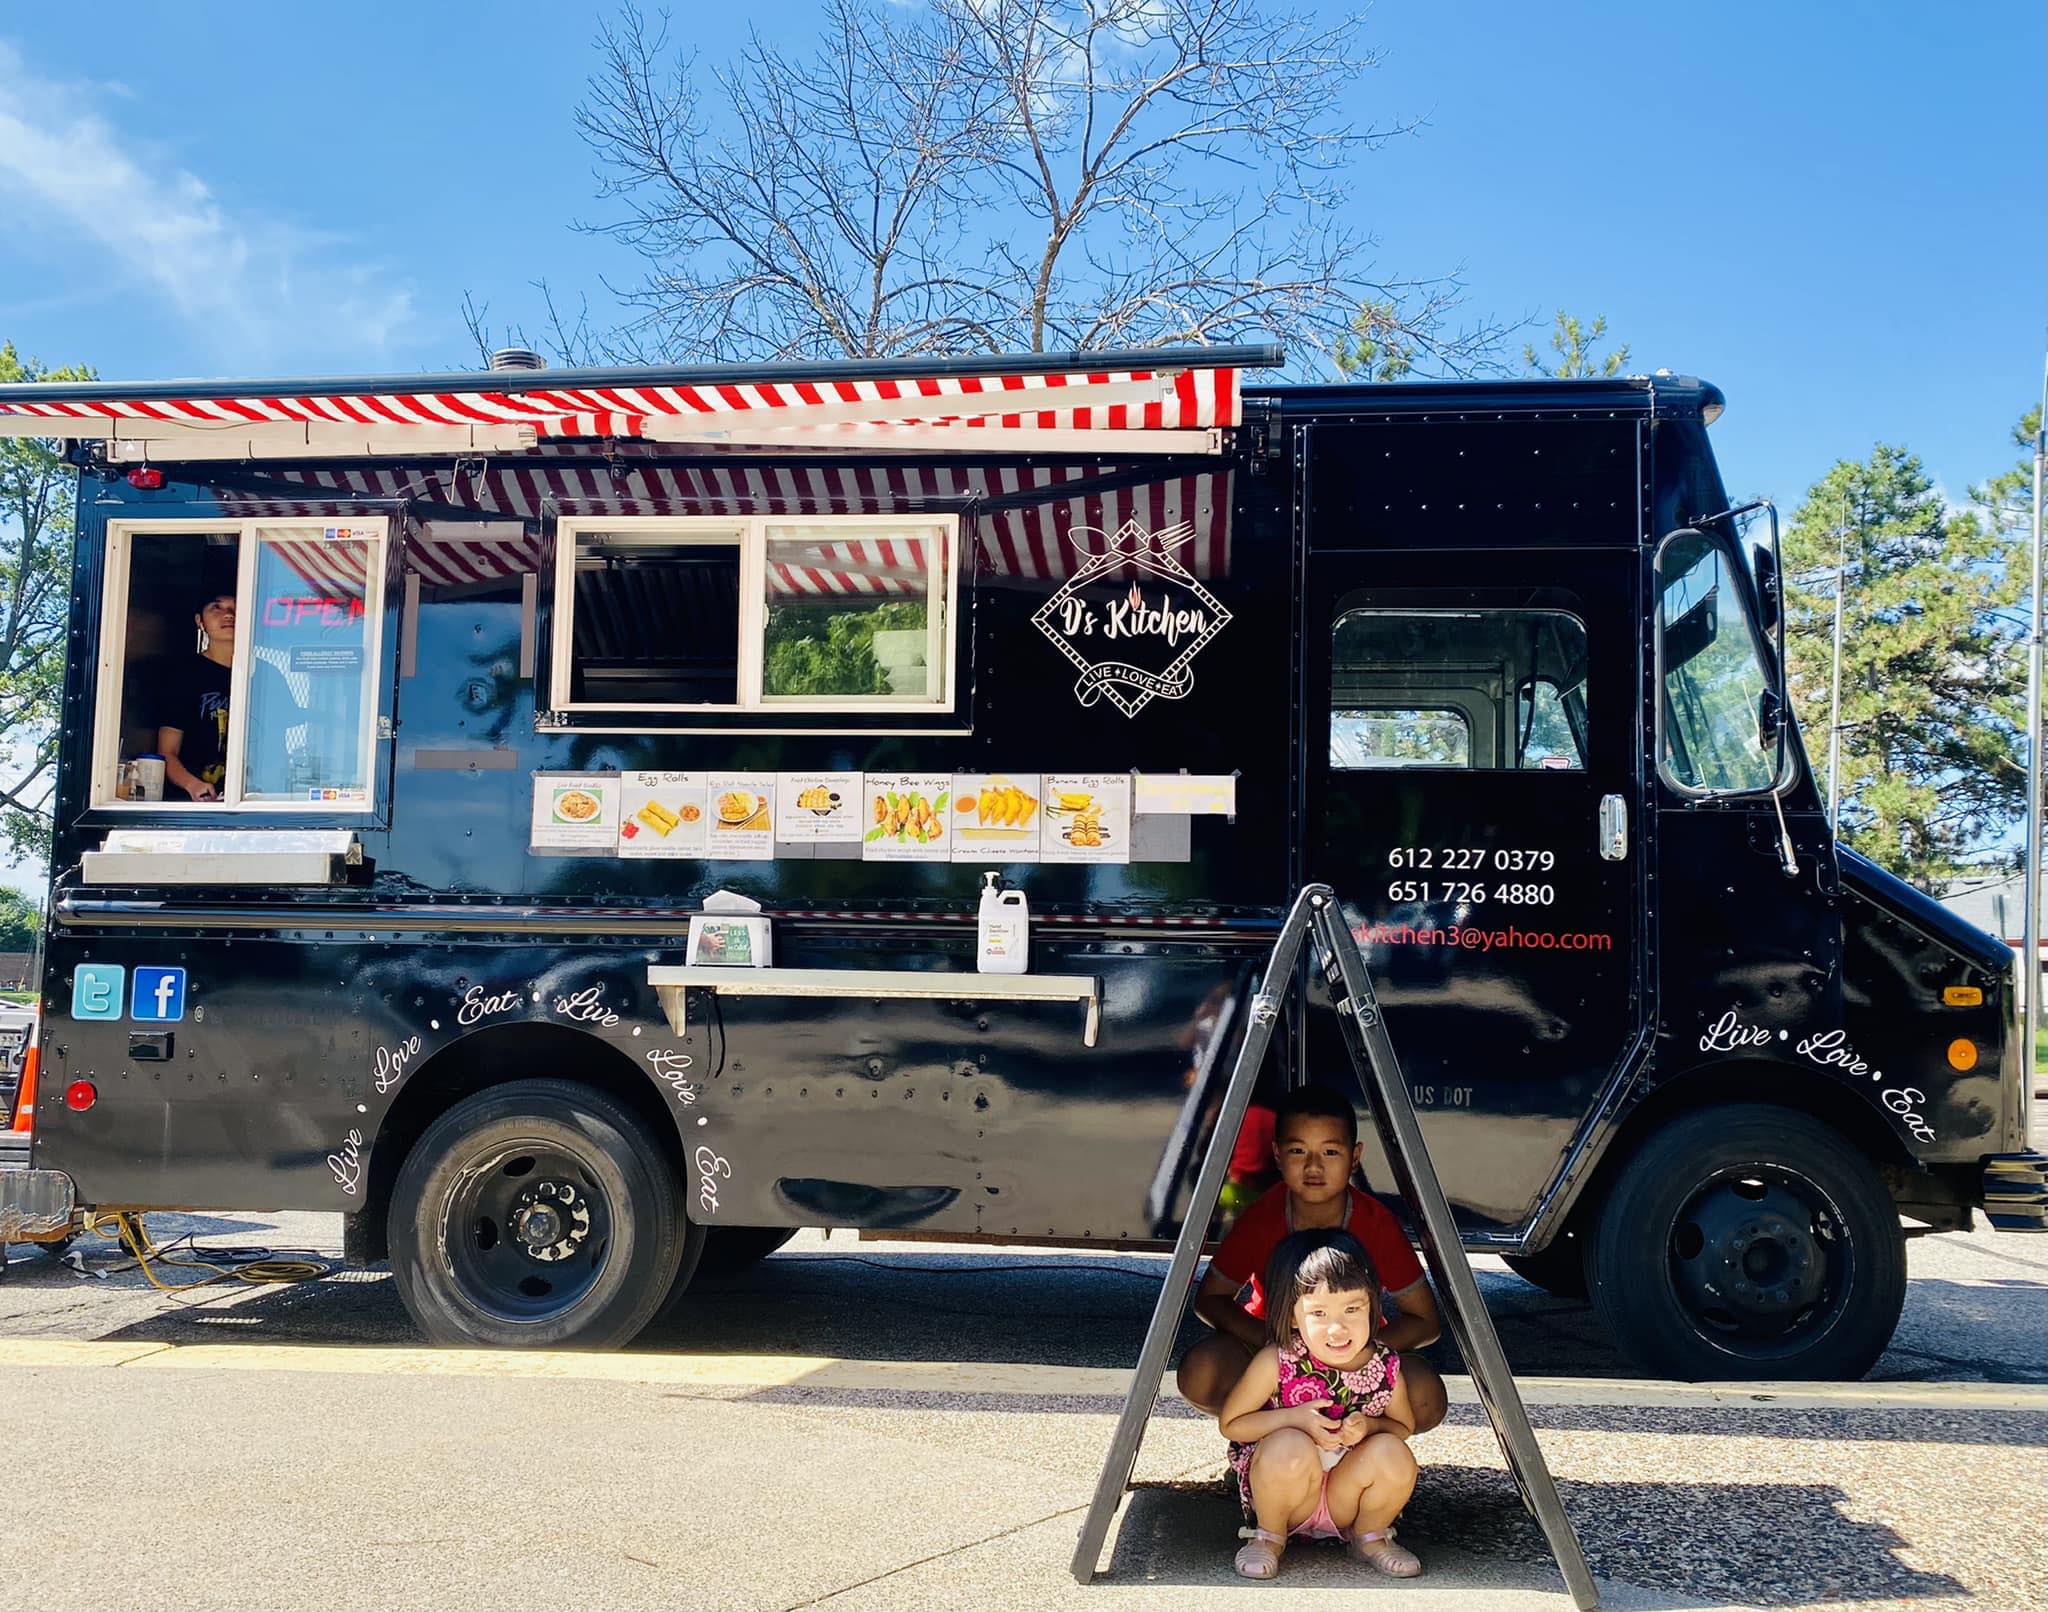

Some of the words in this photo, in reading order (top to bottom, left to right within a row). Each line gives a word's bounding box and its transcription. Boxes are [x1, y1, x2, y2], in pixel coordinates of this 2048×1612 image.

[1059, 596, 1098, 637] D's
[1103, 593, 1207, 648] Kitchen
[1082, 666, 1112, 687] LIVE
[1121, 668, 1155, 689] LOVE
[1160, 683, 1184, 697] EAT
[638, 772, 658, 787] Egg
[663, 772, 689, 783] Rolls
[865, 777, 896, 789] Honey
[900, 776, 919, 786] Bee
[923, 778, 950, 791] Wings
[1047, 776, 1078, 785] Banana
[1082, 777, 1099, 788] Egg
[1103, 777, 1125, 785] Rolls
[1388, 847, 1433, 869] 612
[1441, 848, 1485, 870] 227
[1494, 849, 1555, 872] 0379
[1388, 881, 1430, 903] 651
[1442, 882, 1486, 904] 726
[1493, 883, 1555, 905] 4880
[1350, 922, 1611, 952] skitchen3@yahoo.com
[1699, 1010, 1772, 1052] Live
[1796, 1029, 1868, 1077] Love
[1881, 1086, 1936, 1144] Eat
[327, 1126, 364, 1196] Live
[373, 1034, 422, 1094] Love
[457, 985, 519, 1026] Eat
[557, 986, 620, 1029] Live
[646, 1048, 697, 1106] Love
[695, 1145, 731, 1214] Eat
[1413, 1085, 1434, 1104] US
[1443, 1087, 1473, 1107] DOT
